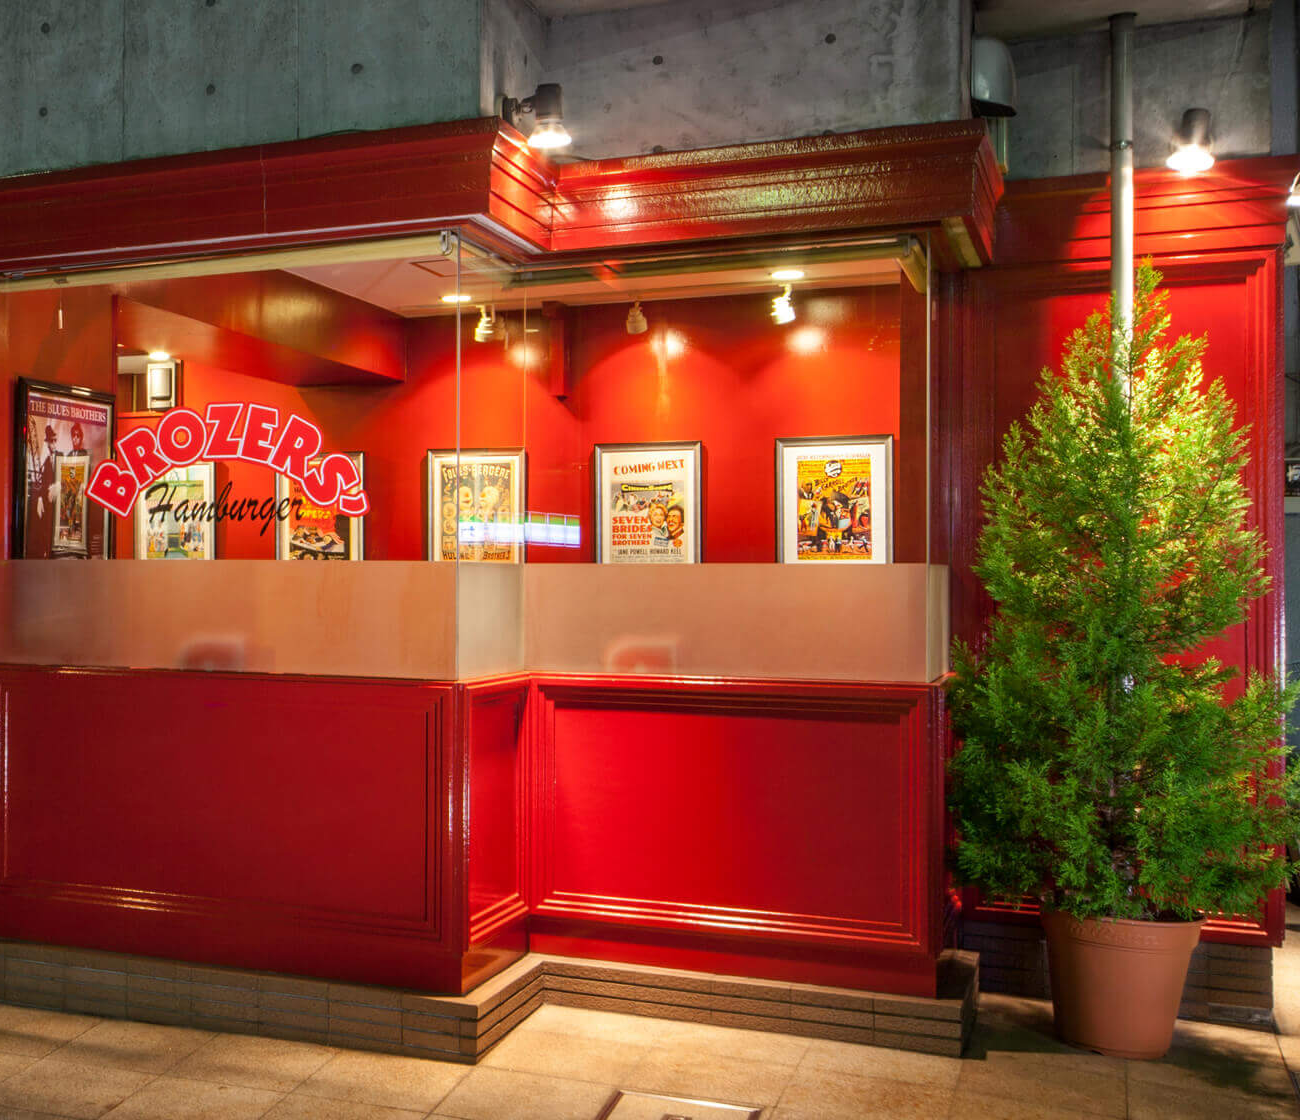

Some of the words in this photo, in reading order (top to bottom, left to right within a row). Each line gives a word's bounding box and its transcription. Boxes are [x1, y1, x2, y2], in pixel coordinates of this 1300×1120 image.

[31, 400, 47, 412] THE
[47, 403, 70, 417] BLUES
[71, 407, 107, 423] BROTHERS
[85, 402, 370, 518] BROZERS'
[613, 462, 655, 476] COMING
[657, 458, 685, 471] NEXT
[144, 482, 306, 537] Hamburger
[612, 516, 650, 525] SEVEN
[612, 525, 653, 534] BRIDES
